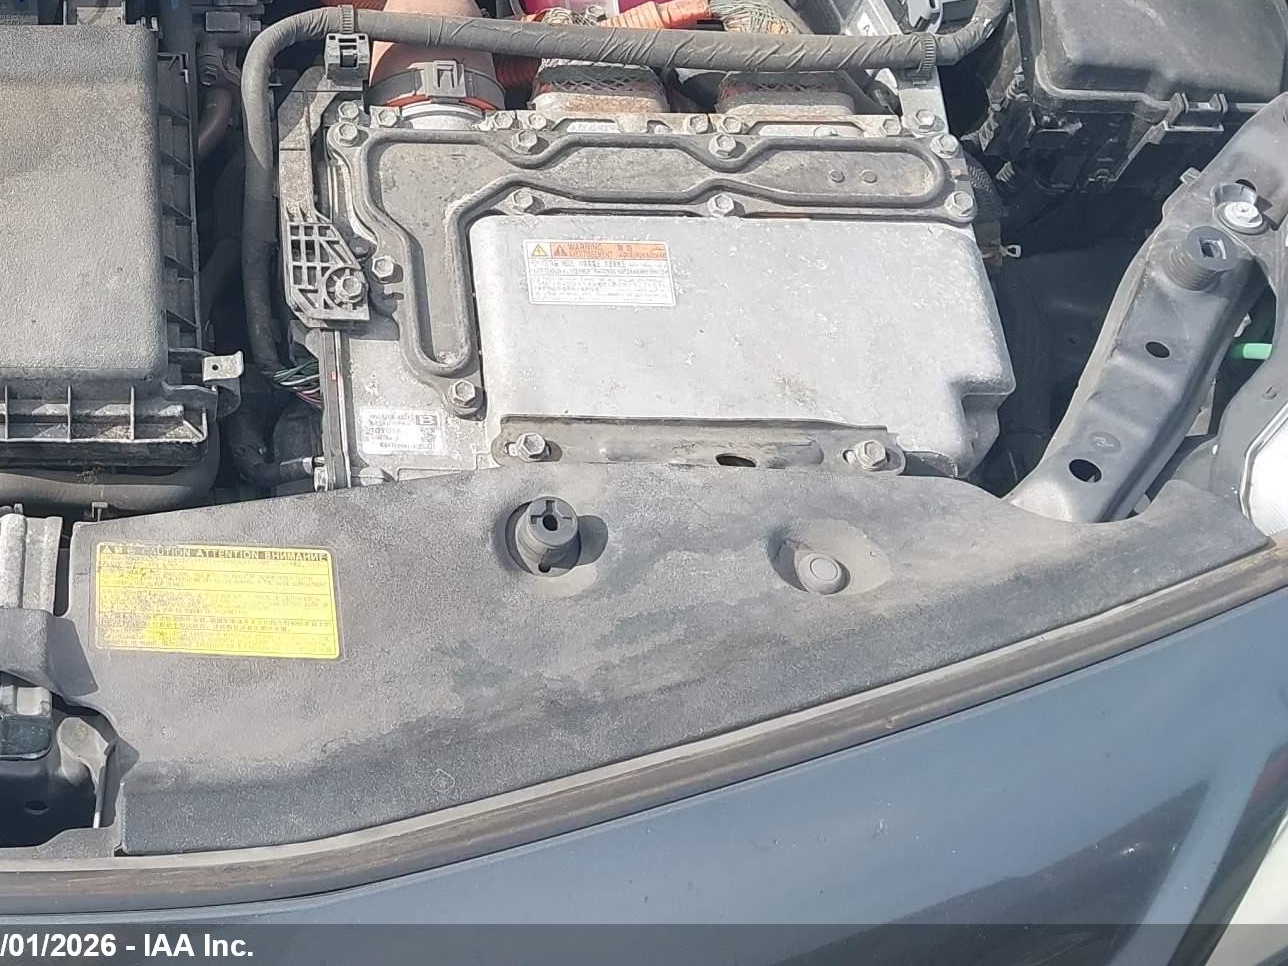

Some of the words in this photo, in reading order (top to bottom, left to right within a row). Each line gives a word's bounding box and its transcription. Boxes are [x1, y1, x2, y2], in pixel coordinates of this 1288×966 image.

[568, 242, 603, 251] WARNING
[197, 548, 259, 559] ATTENTION
[264, 550, 328, 561] ВНИМАНИЕ
